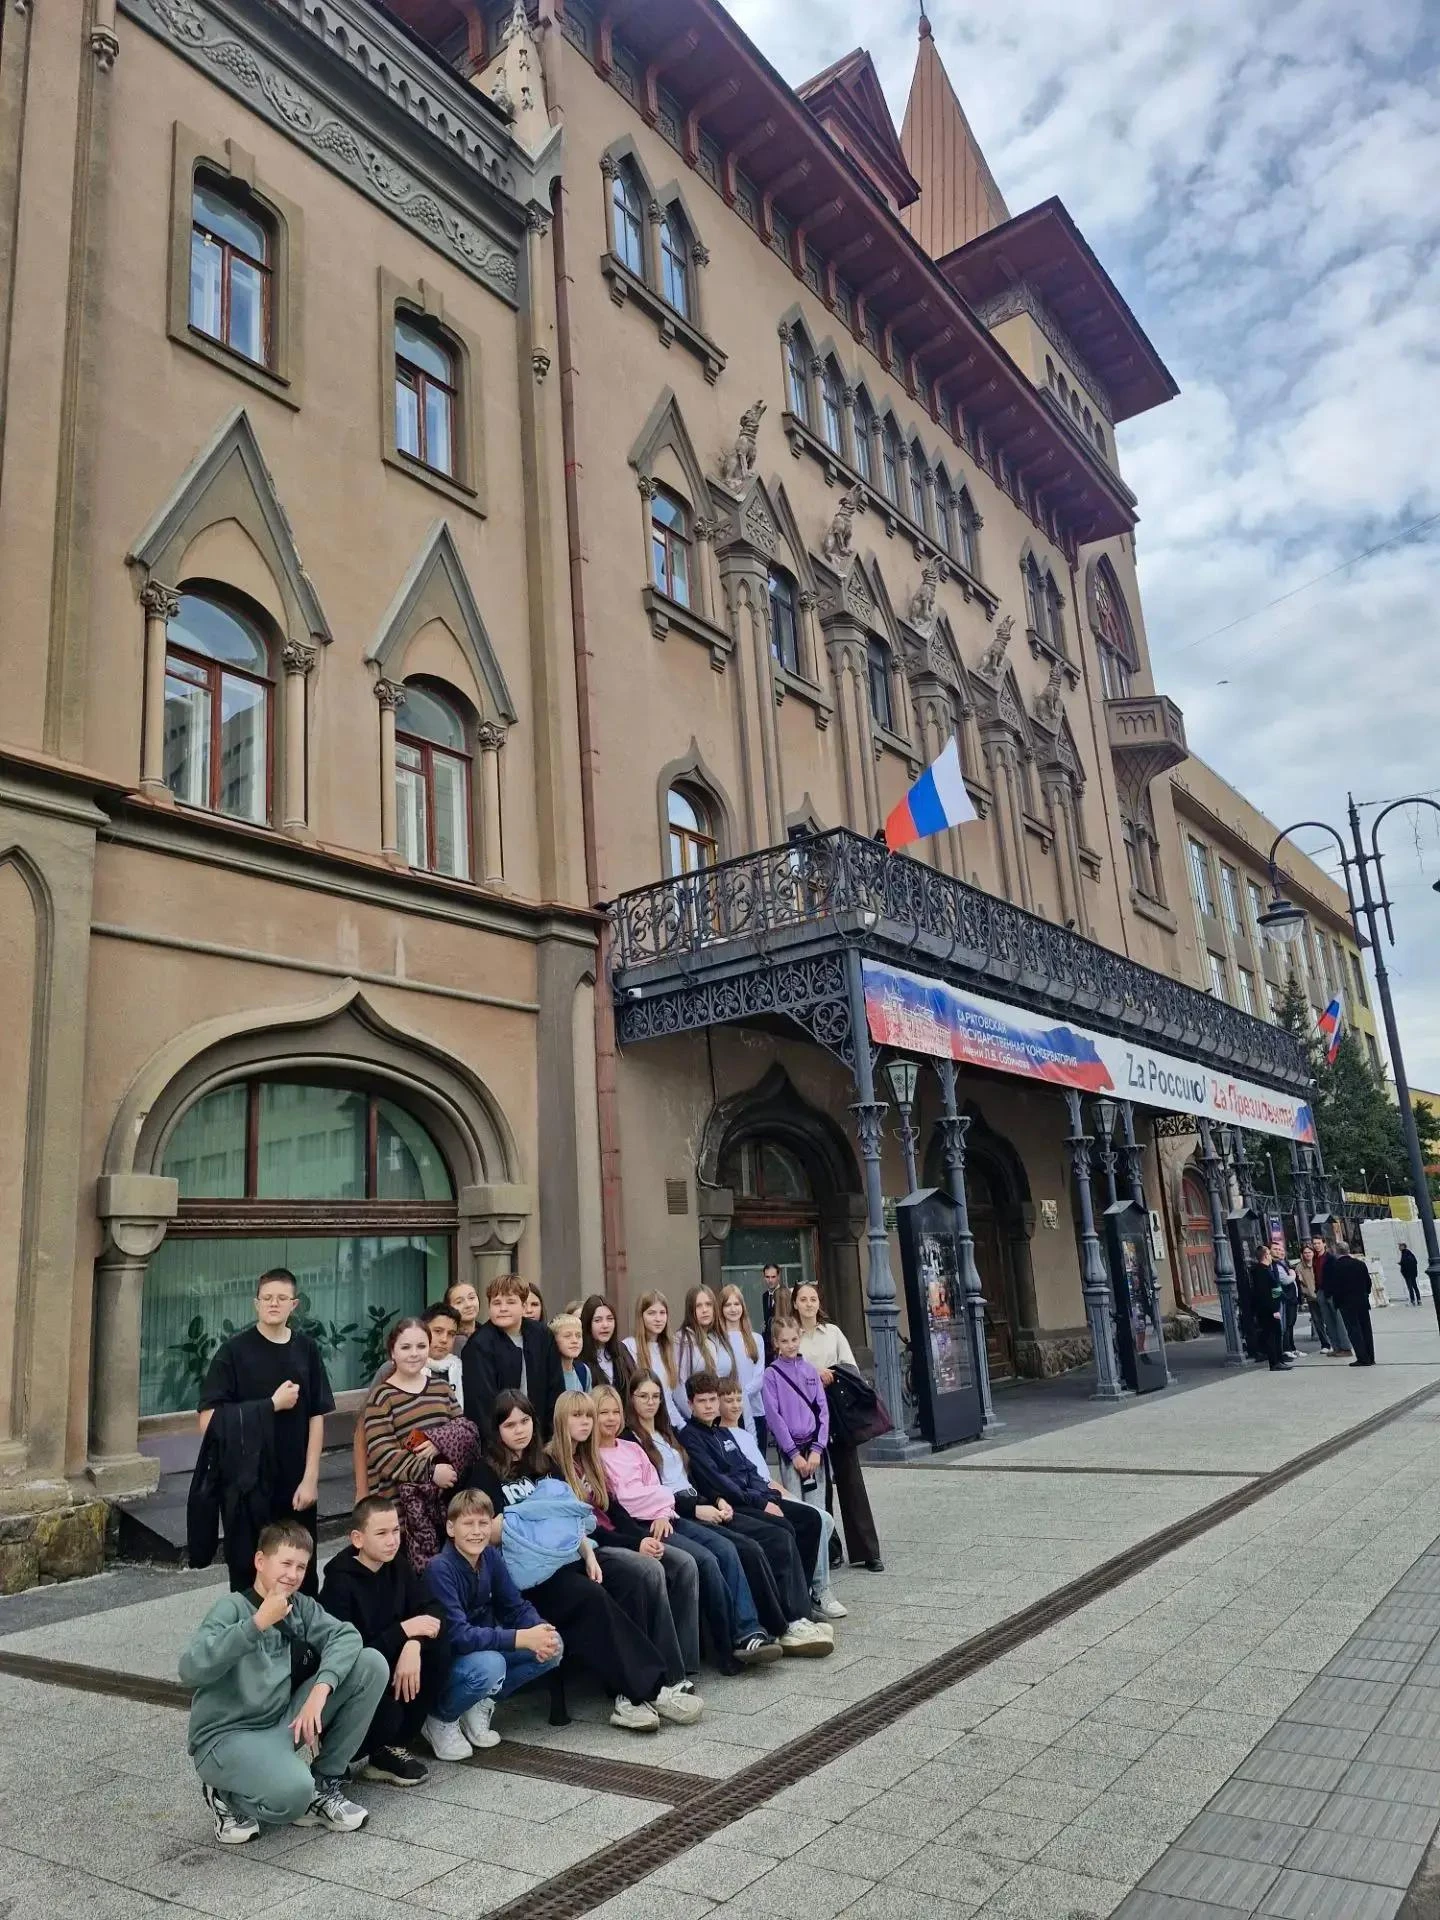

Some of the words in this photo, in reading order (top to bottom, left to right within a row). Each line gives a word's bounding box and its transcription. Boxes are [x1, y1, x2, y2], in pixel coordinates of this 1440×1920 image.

[956, 1009, 1007, 1034] САРАТОВСКАЯ
[960, 1025, 1025, 1053] ГОСУДАРСТВЕННАЯ
[1025, 1043, 1078, 1067] КОНСЕРВАТОРИЯ
[1148, 1059, 1206, 1103] Россию!
